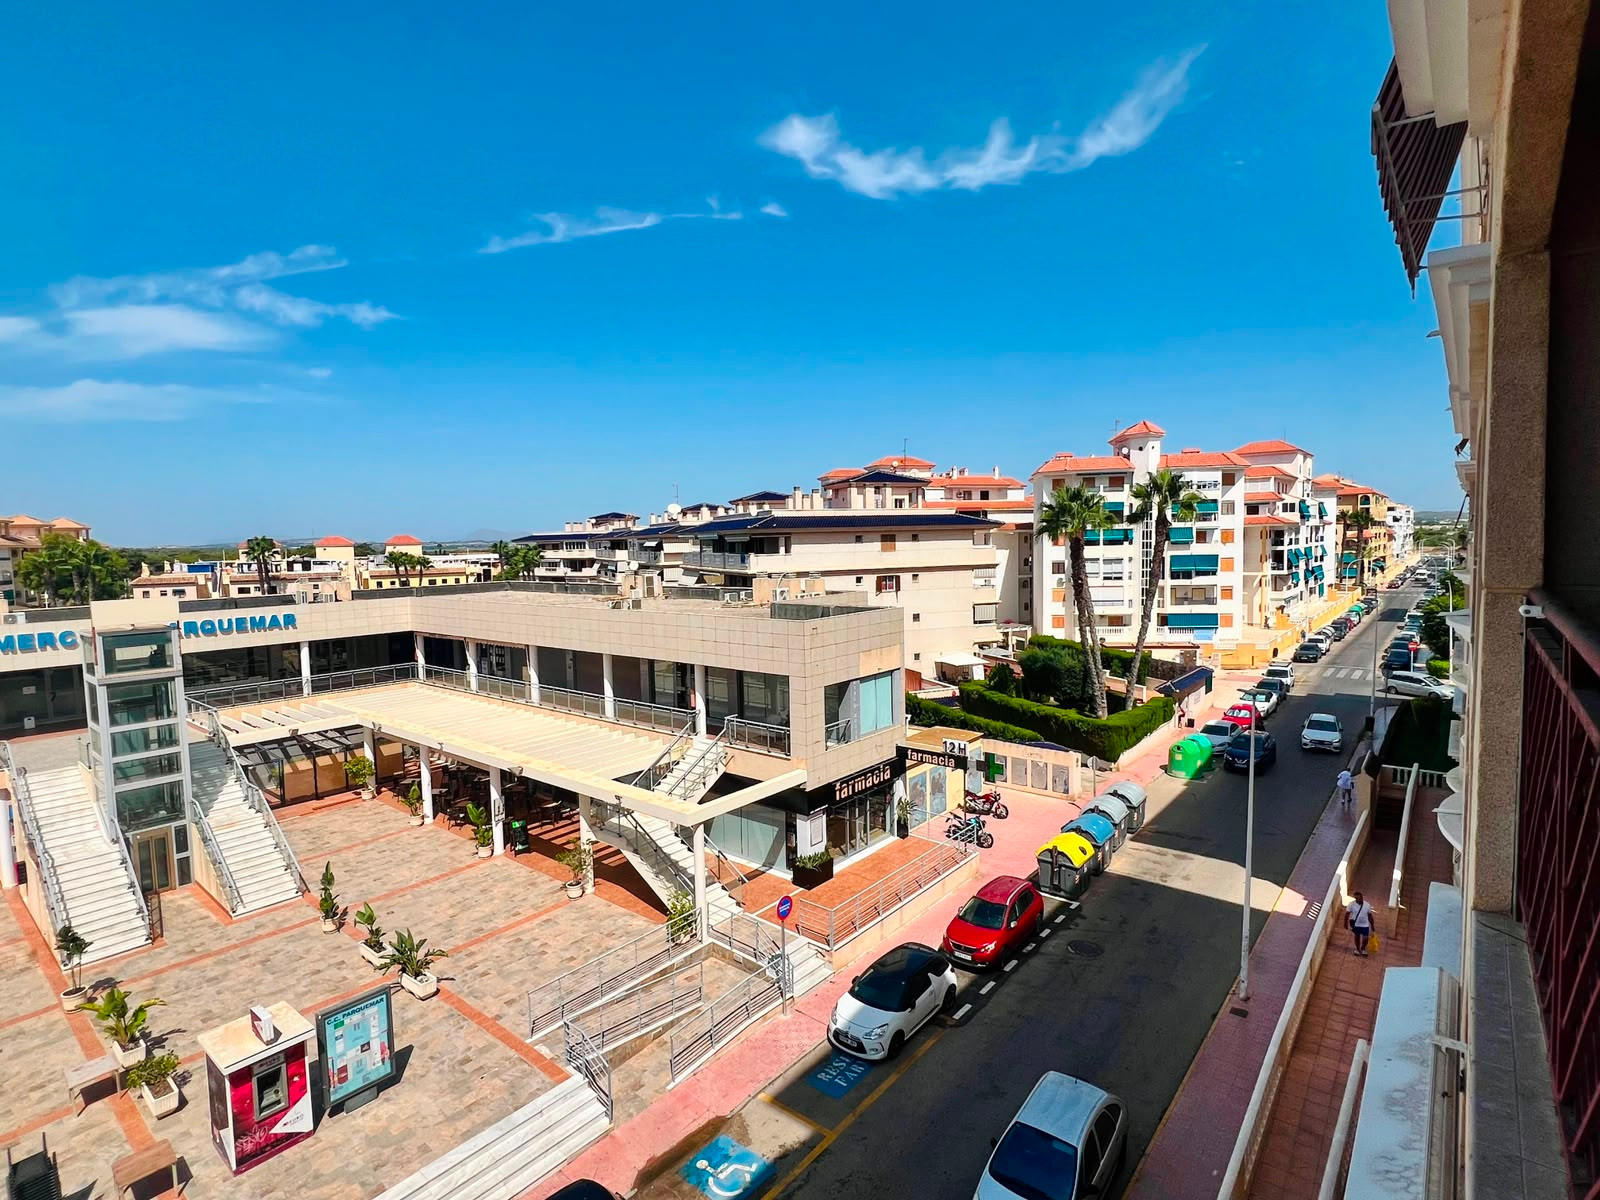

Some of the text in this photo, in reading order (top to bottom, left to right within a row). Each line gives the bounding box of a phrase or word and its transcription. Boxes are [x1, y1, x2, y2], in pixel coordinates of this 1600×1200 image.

[0, 613, 297, 654] MERC RQUEMAR
[907, 748, 955, 768] farmacia
[834, 763, 891, 801] farmacia
[342, 996, 385, 1019] PARQUEMAR
